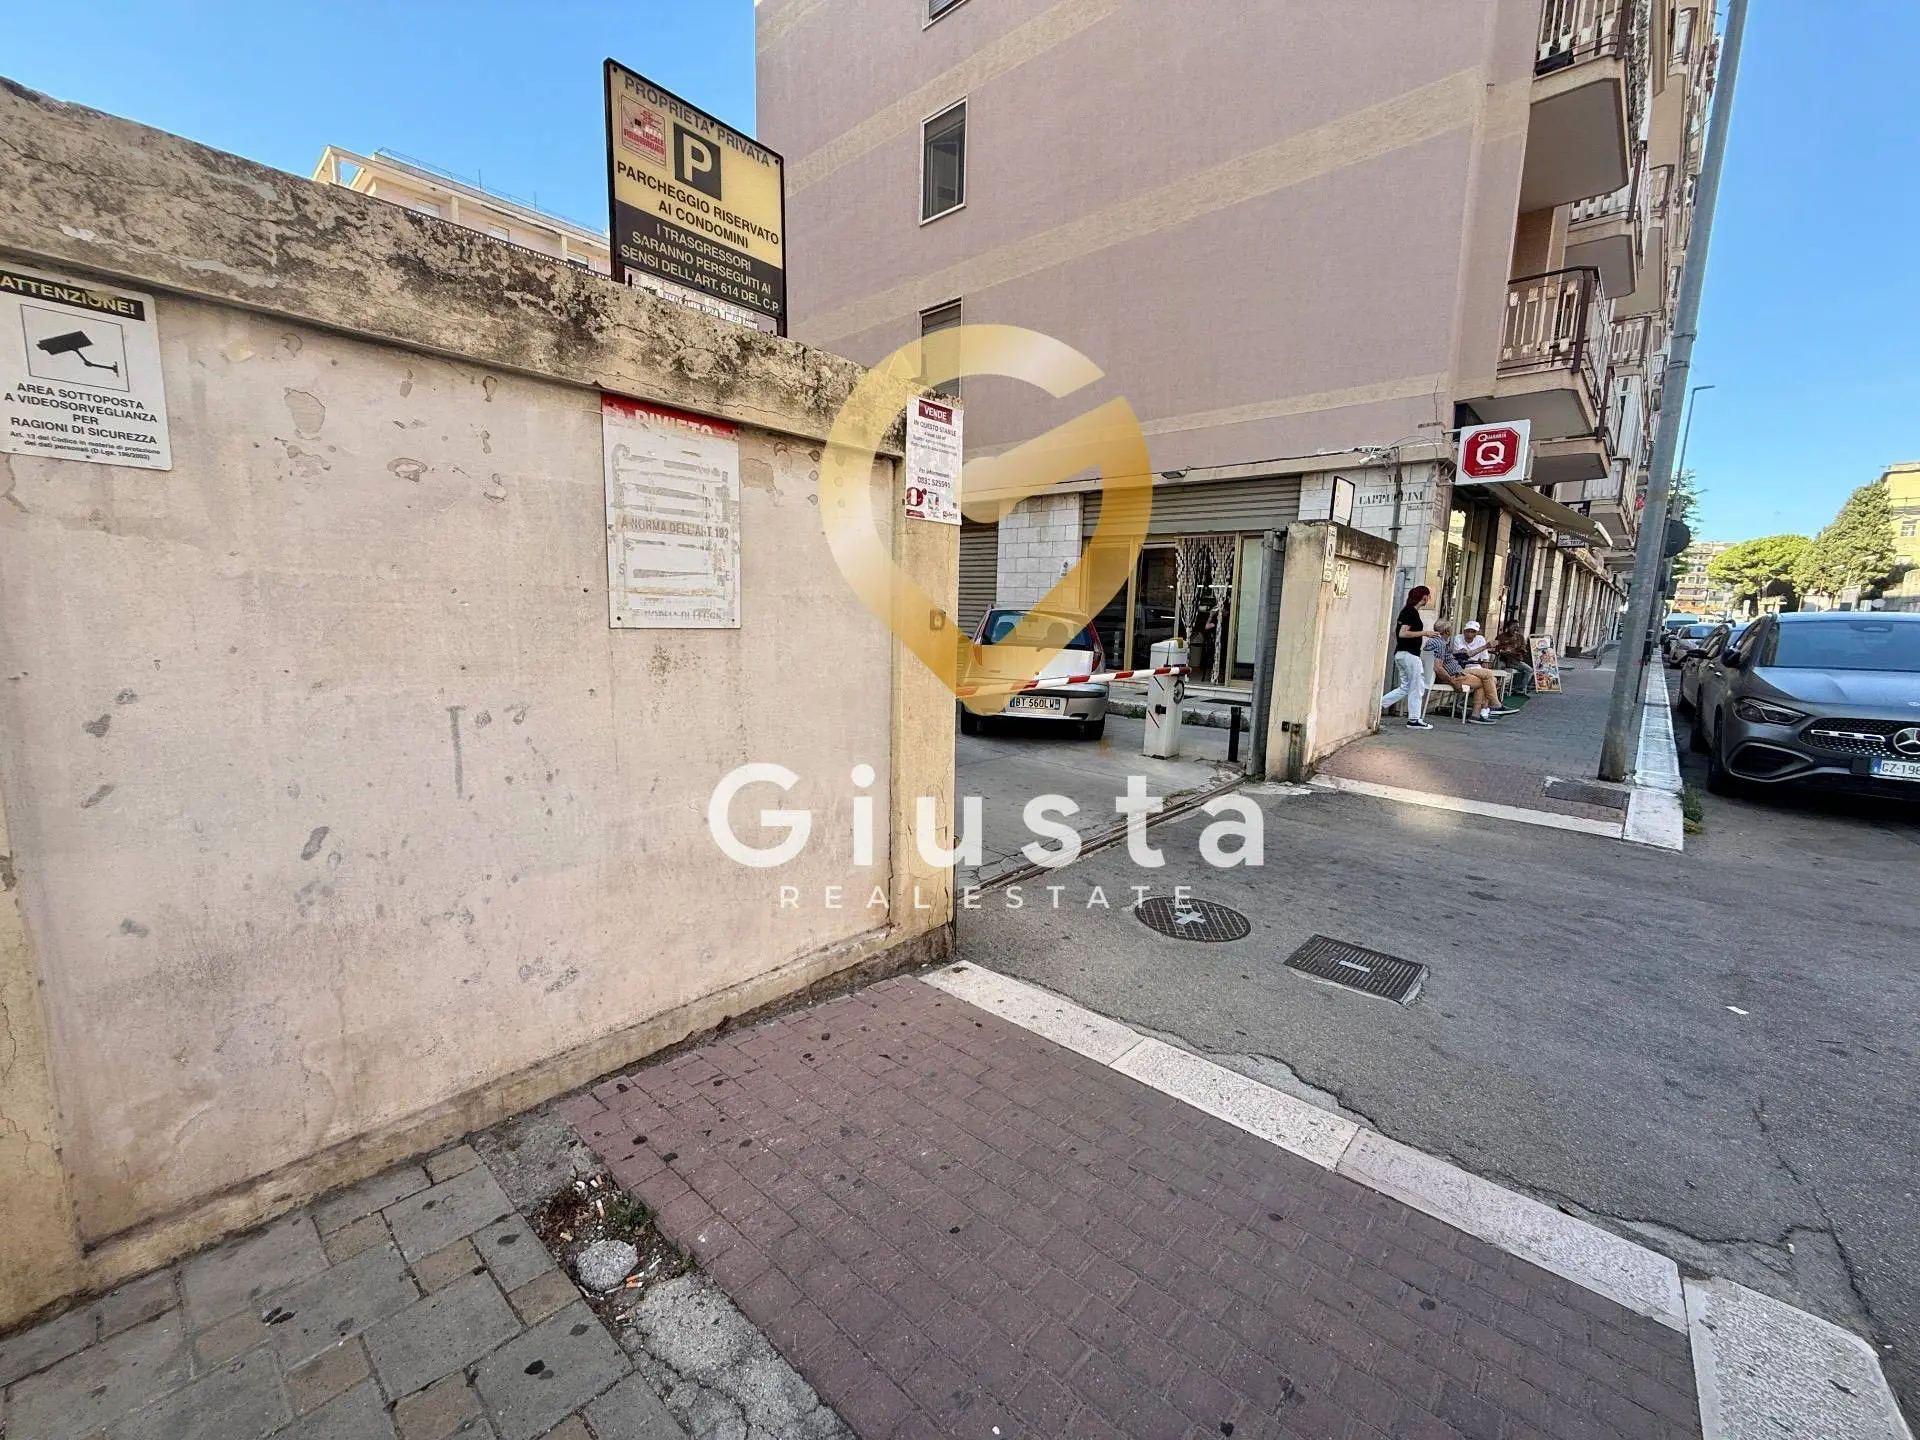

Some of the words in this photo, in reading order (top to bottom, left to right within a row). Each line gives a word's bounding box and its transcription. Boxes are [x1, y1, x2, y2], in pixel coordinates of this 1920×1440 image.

[683, 133, 712, 182] P
[717, 127, 770, 168] PRIVATA
[617, 161, 709, 213] PARCHEGGIO
[714, 206, 779, 245] RISERVATO
[659, 200, 671, 215] AI
[676, 207, 748, 248] CONDOMINI
[656, 223, 661, 235] I
[663, 226, 751, 271] TRASGRESSORI
[621, 244, 658, 269] SENSI
[721, 283, 739, 298] 614
[741, 290, 761, 306] DEL
[632, 231, 694, 264] SARANNO
[696, 257, 759, 290] PERSEGUITI
[761, 282, 771, 294] AI
[1, 276, 136, 315] ATTENZIONE!
[4, 393, 14, 402] A
[18, 394, 158, 422] VIDEOSORVEGLIANZA
[17, 382, 55, 396] AREA
[59, 389, 144, 409] SOTTOPOSTA
[73, 414, 99, 425] PER
[920, 421, 939, 432] QUESTO
[924, 405, 947, 420] VENDE
[11, 417, 68, 432] RAGIONI
[72, 425, 84, 434] DI
[88, 427, 157, 444] SICUREZZA
[52, 436, 77, 445] Codice
[88, 441, 115, 449] materia
[125, 446, 160, 455] protezione
[54, 444, 89, 453] personali
[1476, 441, 1506, 466] Q
